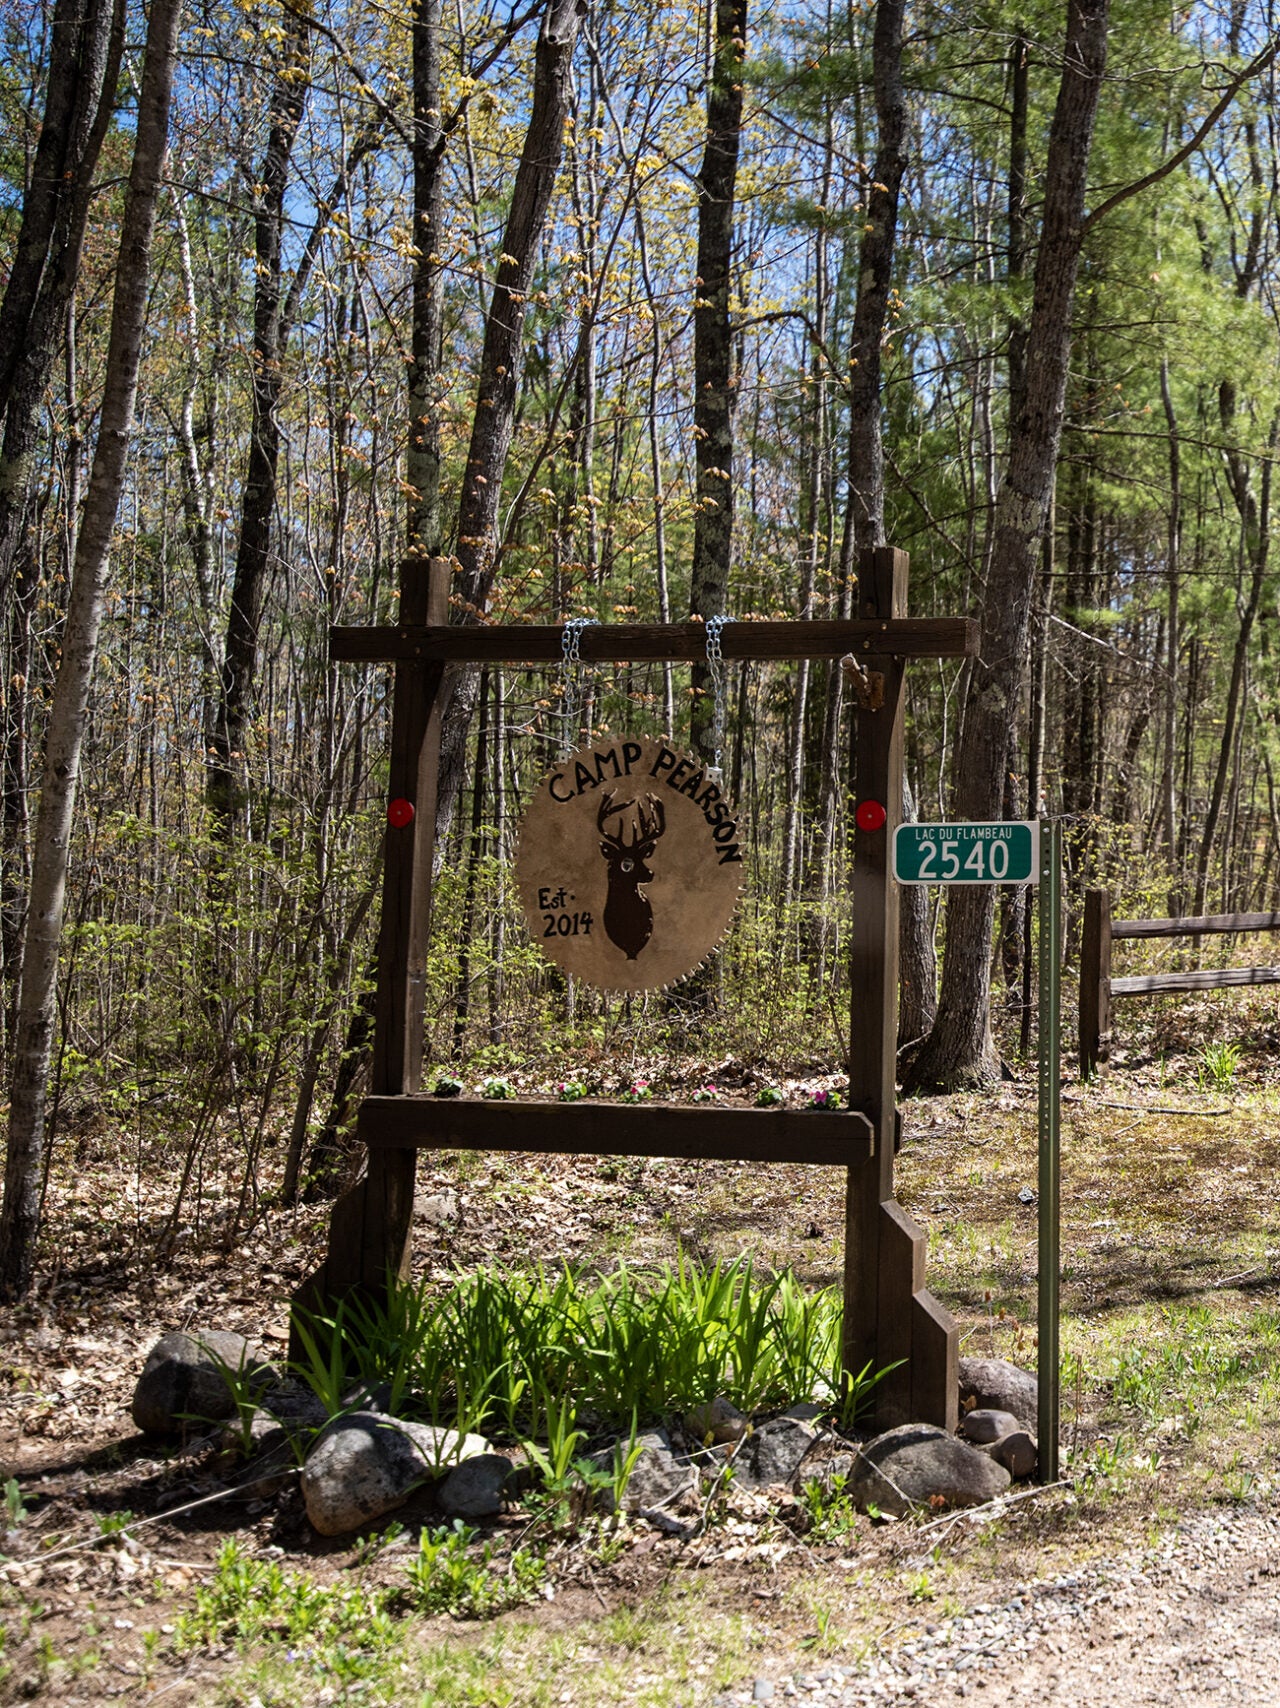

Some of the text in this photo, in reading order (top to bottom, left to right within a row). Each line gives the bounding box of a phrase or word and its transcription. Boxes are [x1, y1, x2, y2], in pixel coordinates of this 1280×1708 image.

[549, 742, 743, 866] CAMP PEARSON
[915, 827, 1013, 840] LAC DU FLAMBEAU
[917, 840, 1009, 879] 2540
[543, 912, 594, 937] 2014
